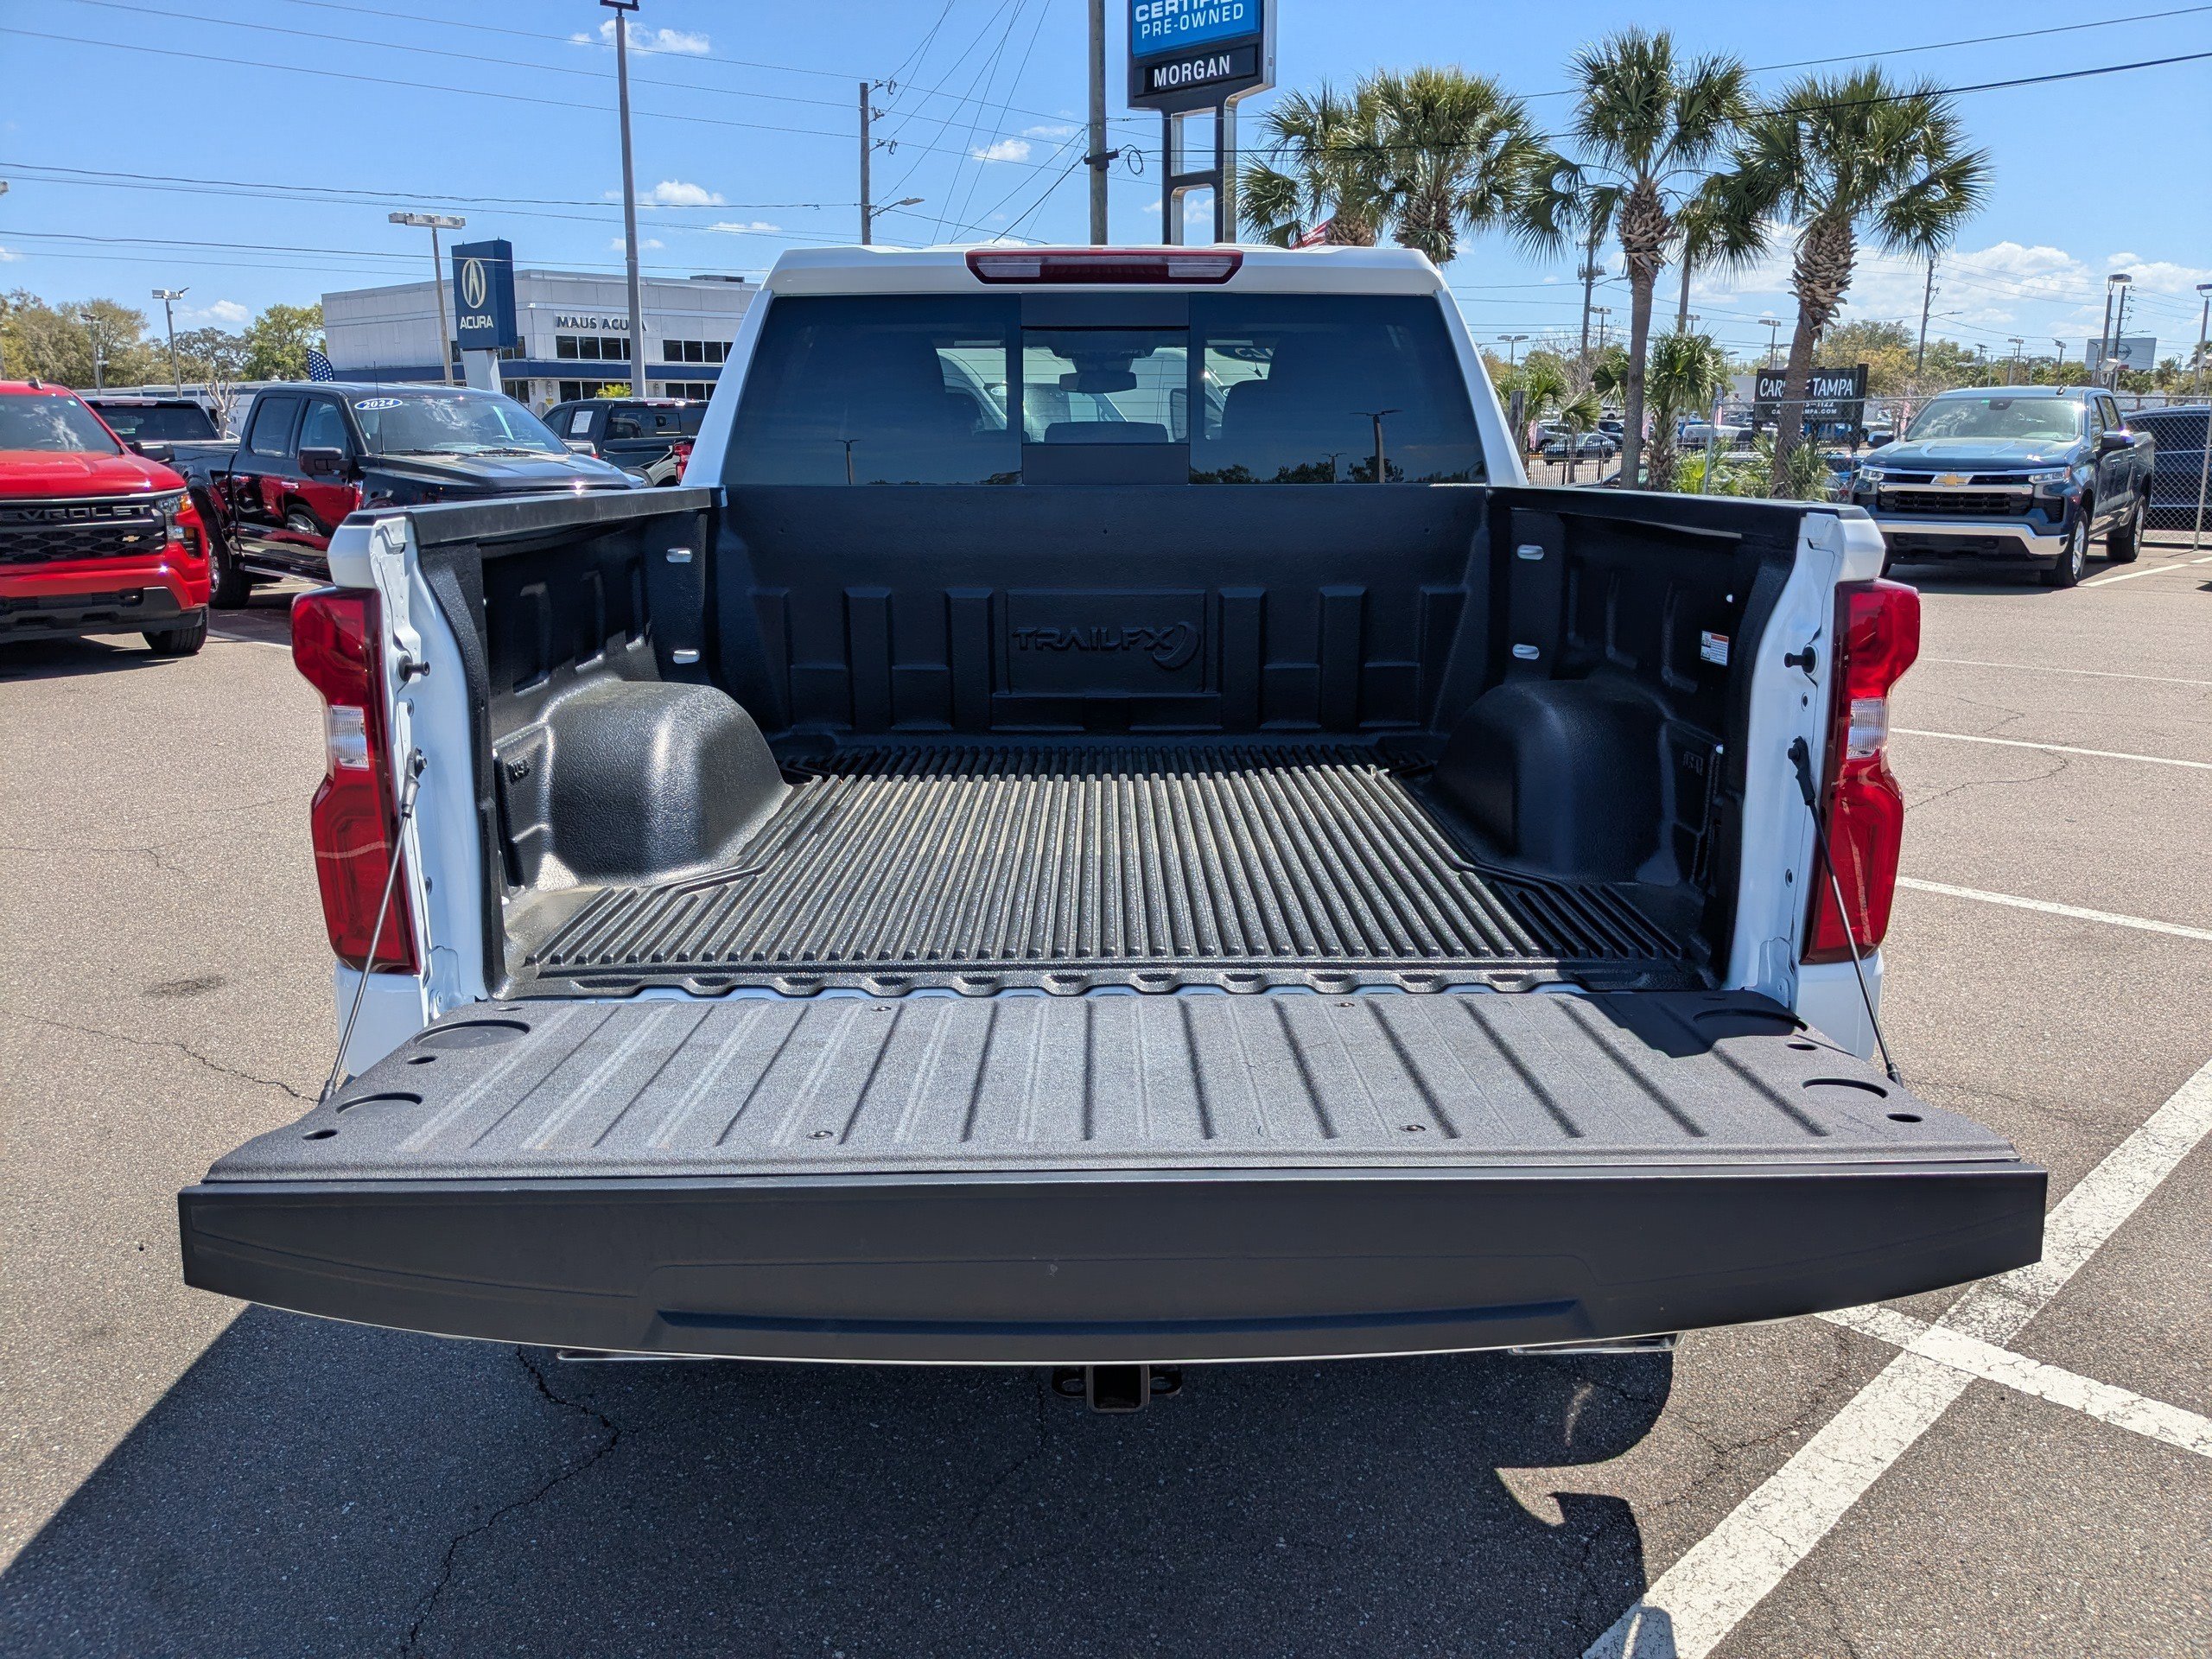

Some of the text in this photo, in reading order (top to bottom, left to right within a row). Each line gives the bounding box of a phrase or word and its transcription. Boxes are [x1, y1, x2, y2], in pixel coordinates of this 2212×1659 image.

[1135, 0, 1233, 22] CERTIF
[1141, 3, 1243, 39] PRE-OWNED
[1154, 54, 1230, 87] MORGAN
[460, 315, 493, 329] ACURA
[556, 315, 646, 331] MAUS ACUA
[1812, 378, 1853, 397] TAMPA
[363, 399, 394, 409] 2024
[1012, 626, 1176, 652] TRAILFX
